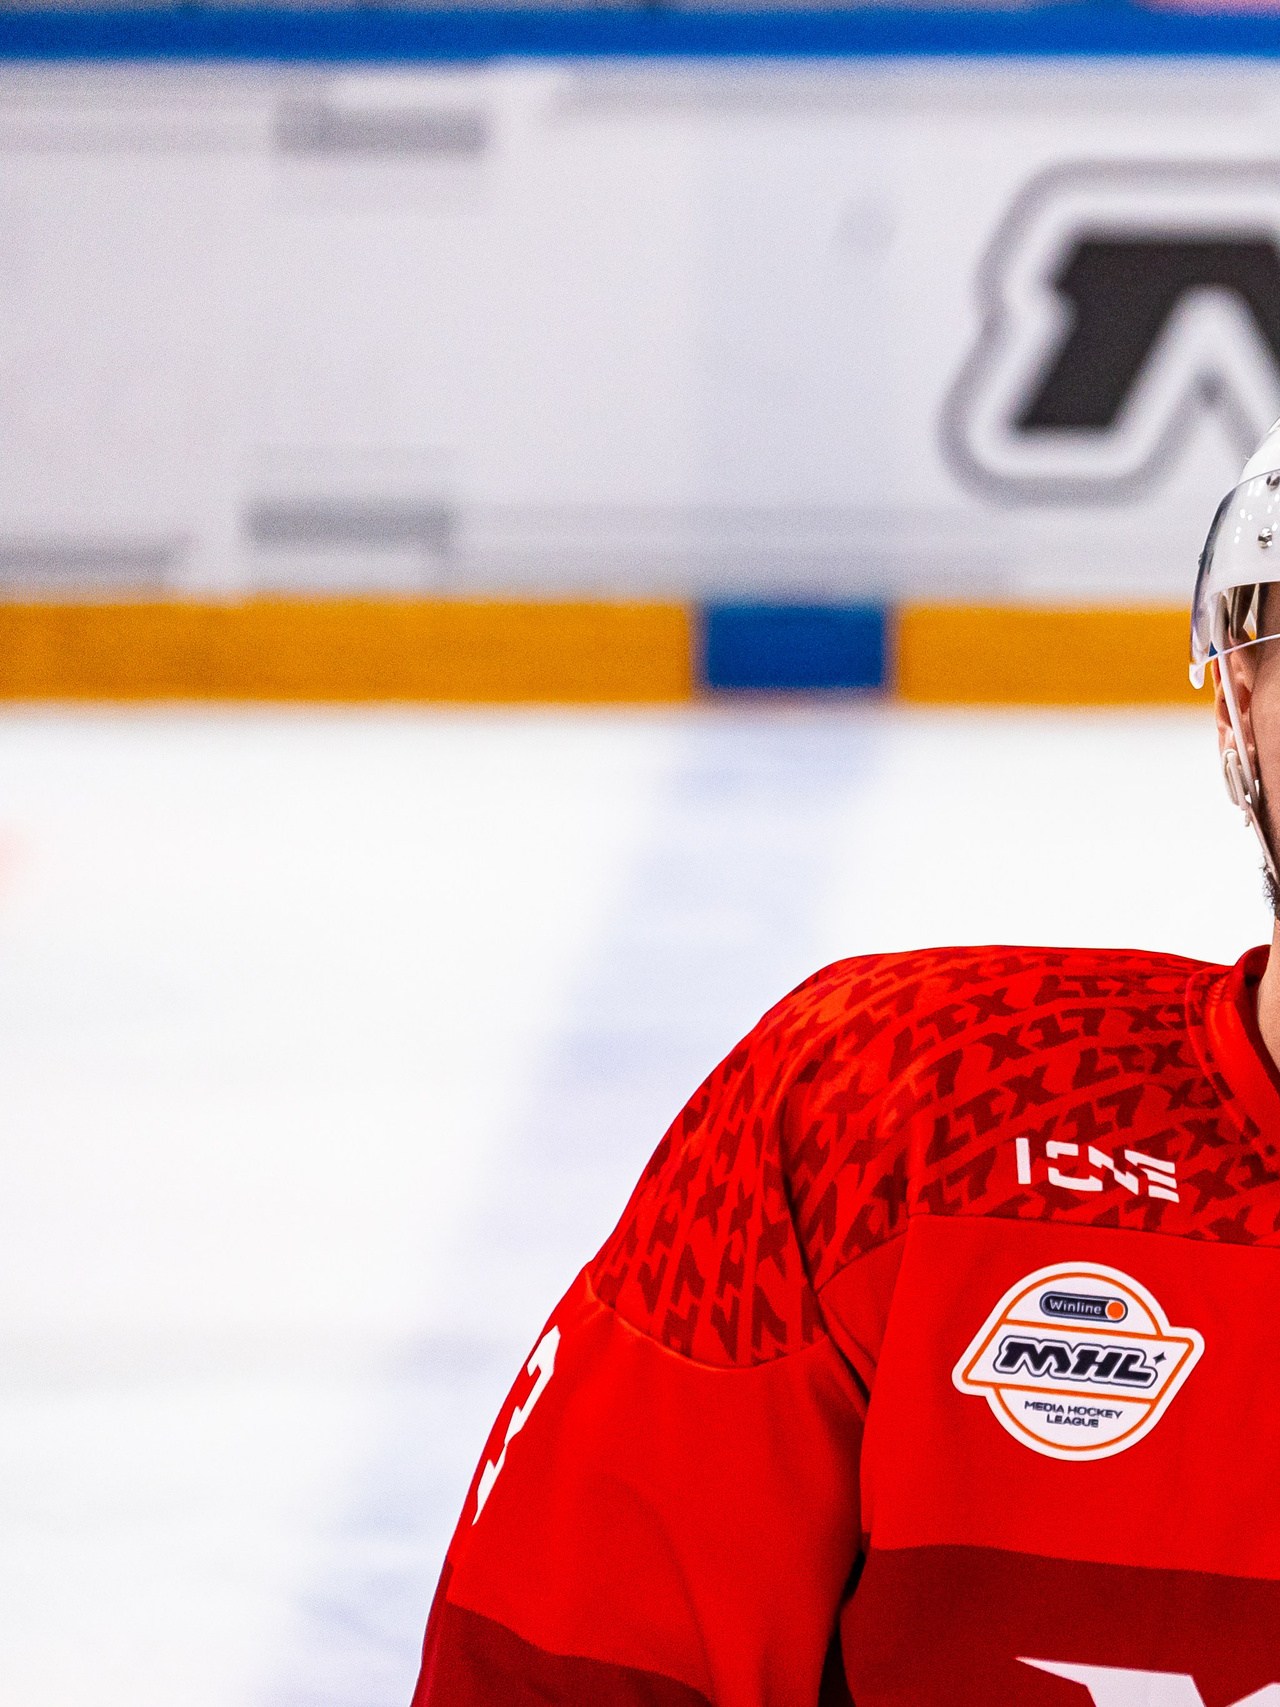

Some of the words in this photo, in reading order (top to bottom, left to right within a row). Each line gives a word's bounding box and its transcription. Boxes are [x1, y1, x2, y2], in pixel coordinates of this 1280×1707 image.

[1049, 1299, 1102, 1315] Winline
[999, 1341, 1152, 1382] MHL
[1024, 1400, 1064, 1414] MEDIA
[1067, 1406, 1123, 1420] HOCKEY
[1046, 1415, 1099, 1428] LEAGUE
